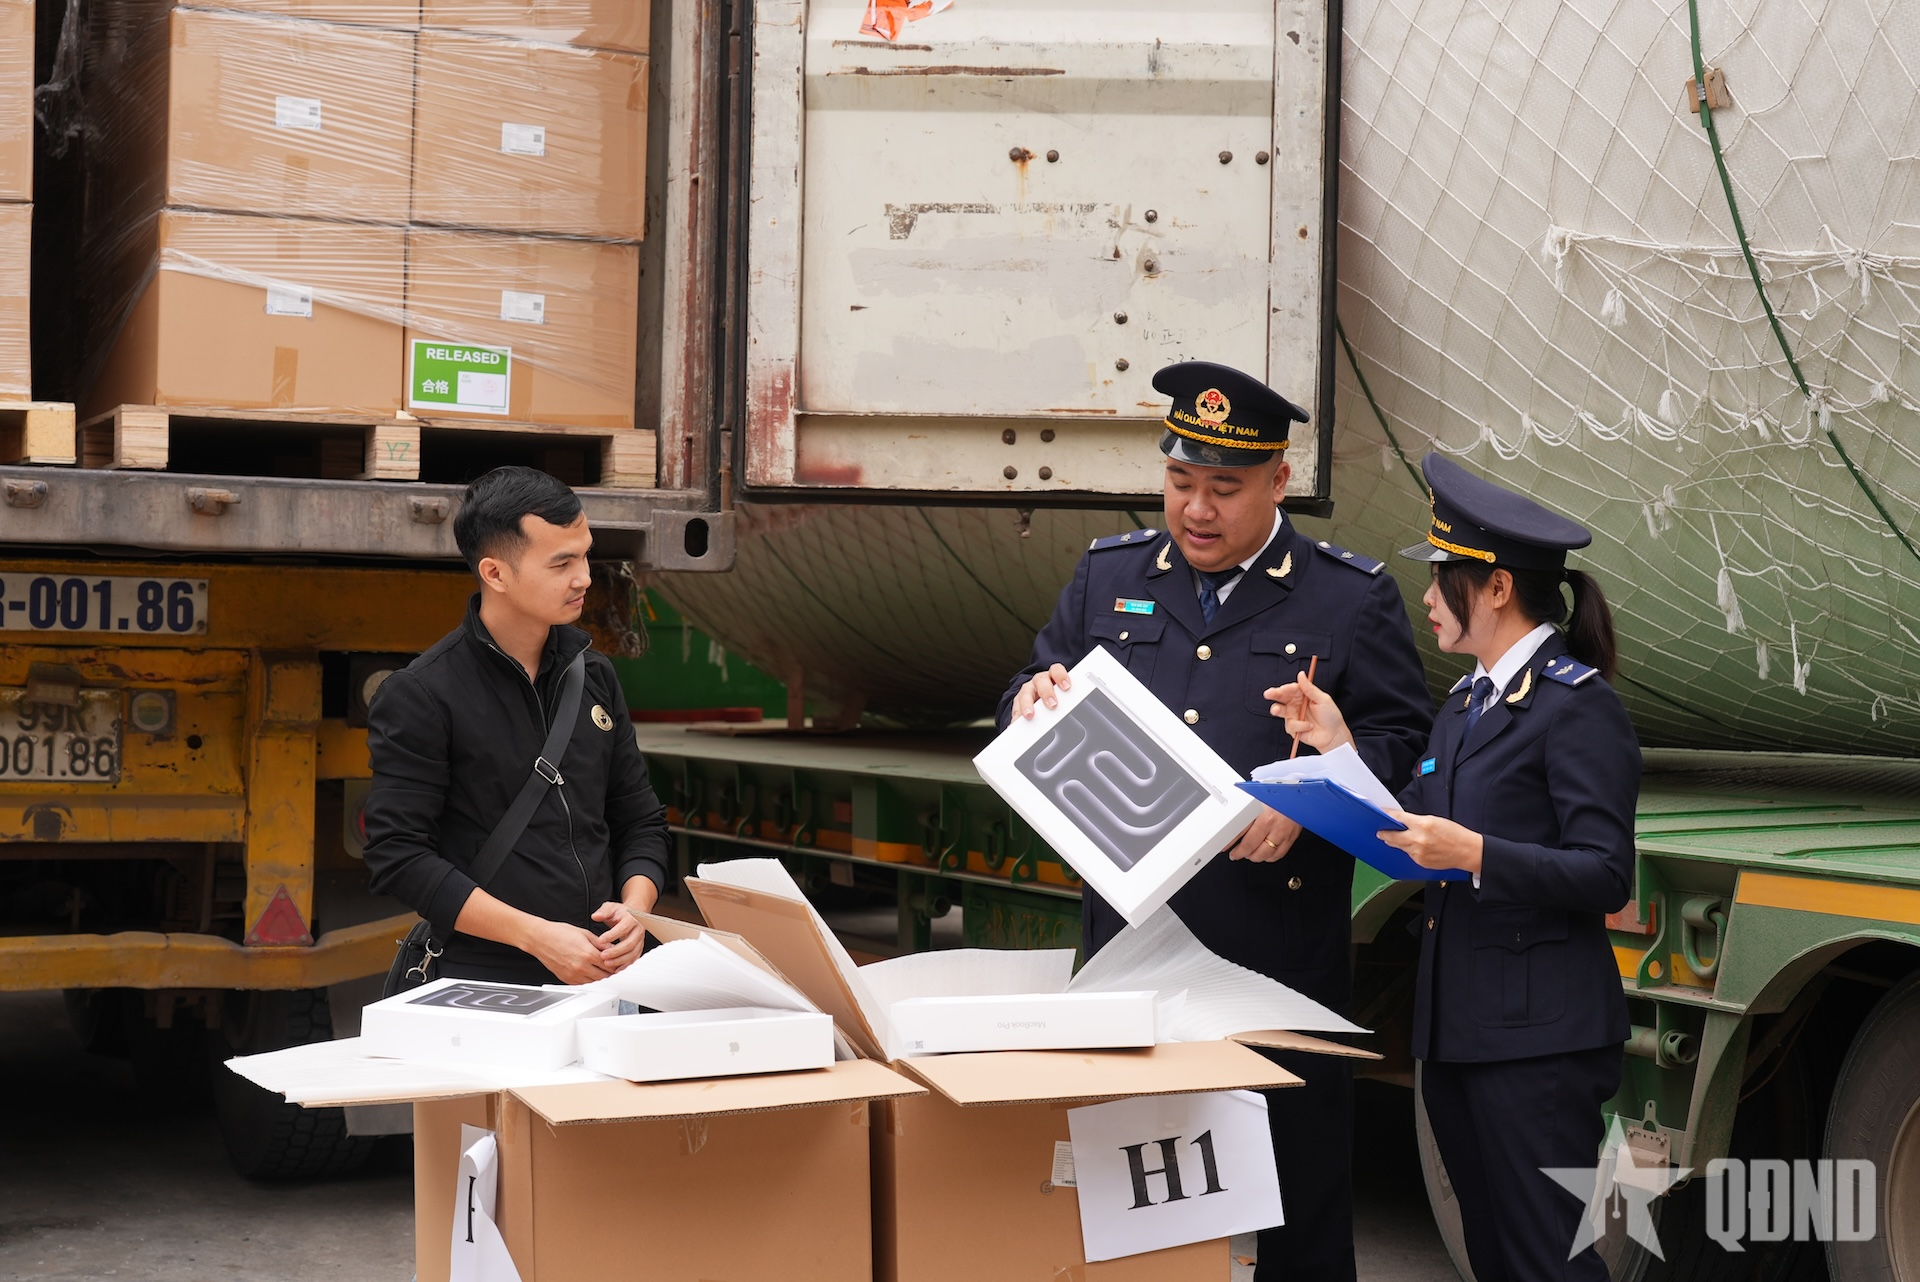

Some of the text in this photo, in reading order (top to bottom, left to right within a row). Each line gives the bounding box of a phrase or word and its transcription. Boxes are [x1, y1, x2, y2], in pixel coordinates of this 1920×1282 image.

[426, 347, 501, 365] RELEASED
[422, 379, 449, 395] 合格
[1235, 426, 1259, 437] NAM
[1435, 519, 1451, 533] NAM
[0, 576, 194, 632] -001.86
[997, 1021, 1046, 1030] MacBook Pro
[1119, 1129, 1229, 1211] H1
